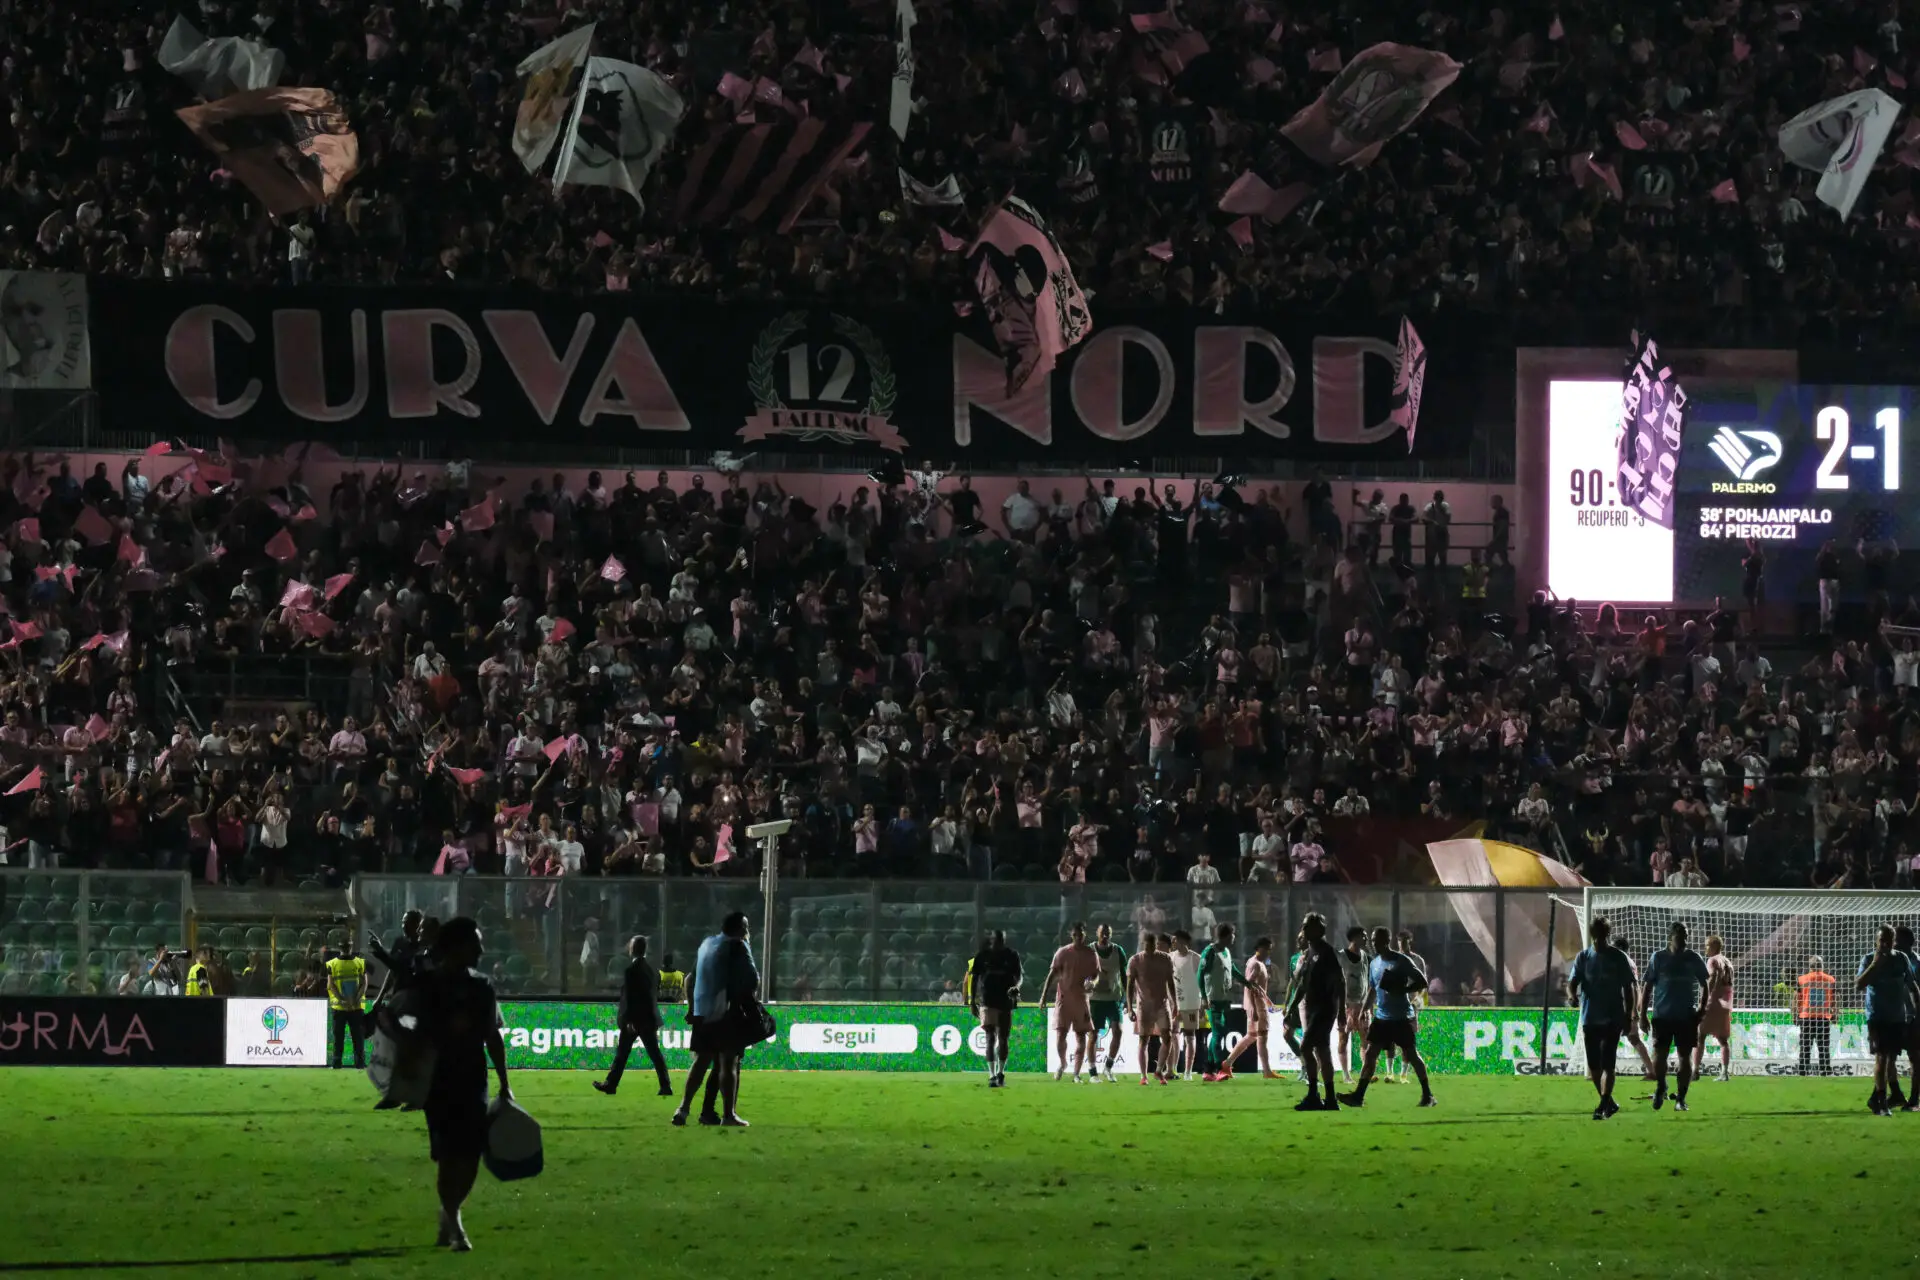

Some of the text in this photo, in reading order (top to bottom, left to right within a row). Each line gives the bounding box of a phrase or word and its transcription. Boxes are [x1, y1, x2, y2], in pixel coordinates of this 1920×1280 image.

[164, 303, 691, 431] CURVA
[952, 324, 1405, 446] NORD
[781, 342, 858, 404] 12
[771, 410, 876, 434] PALERMO
[1816, 406, 1900, 490] 2-1
[1712, 482, 1776, 494] PALERMO
[1577, 509, 1628, 527] RECUPERO
[1700, 507, 1832, 524] 38' POHJANPALO
[1700, 524, 1796, 539] 64' PIEROZZI
[822, 1028, 876, 1049] Segui
[246, 1045, 304, 1057] PRAGMA
